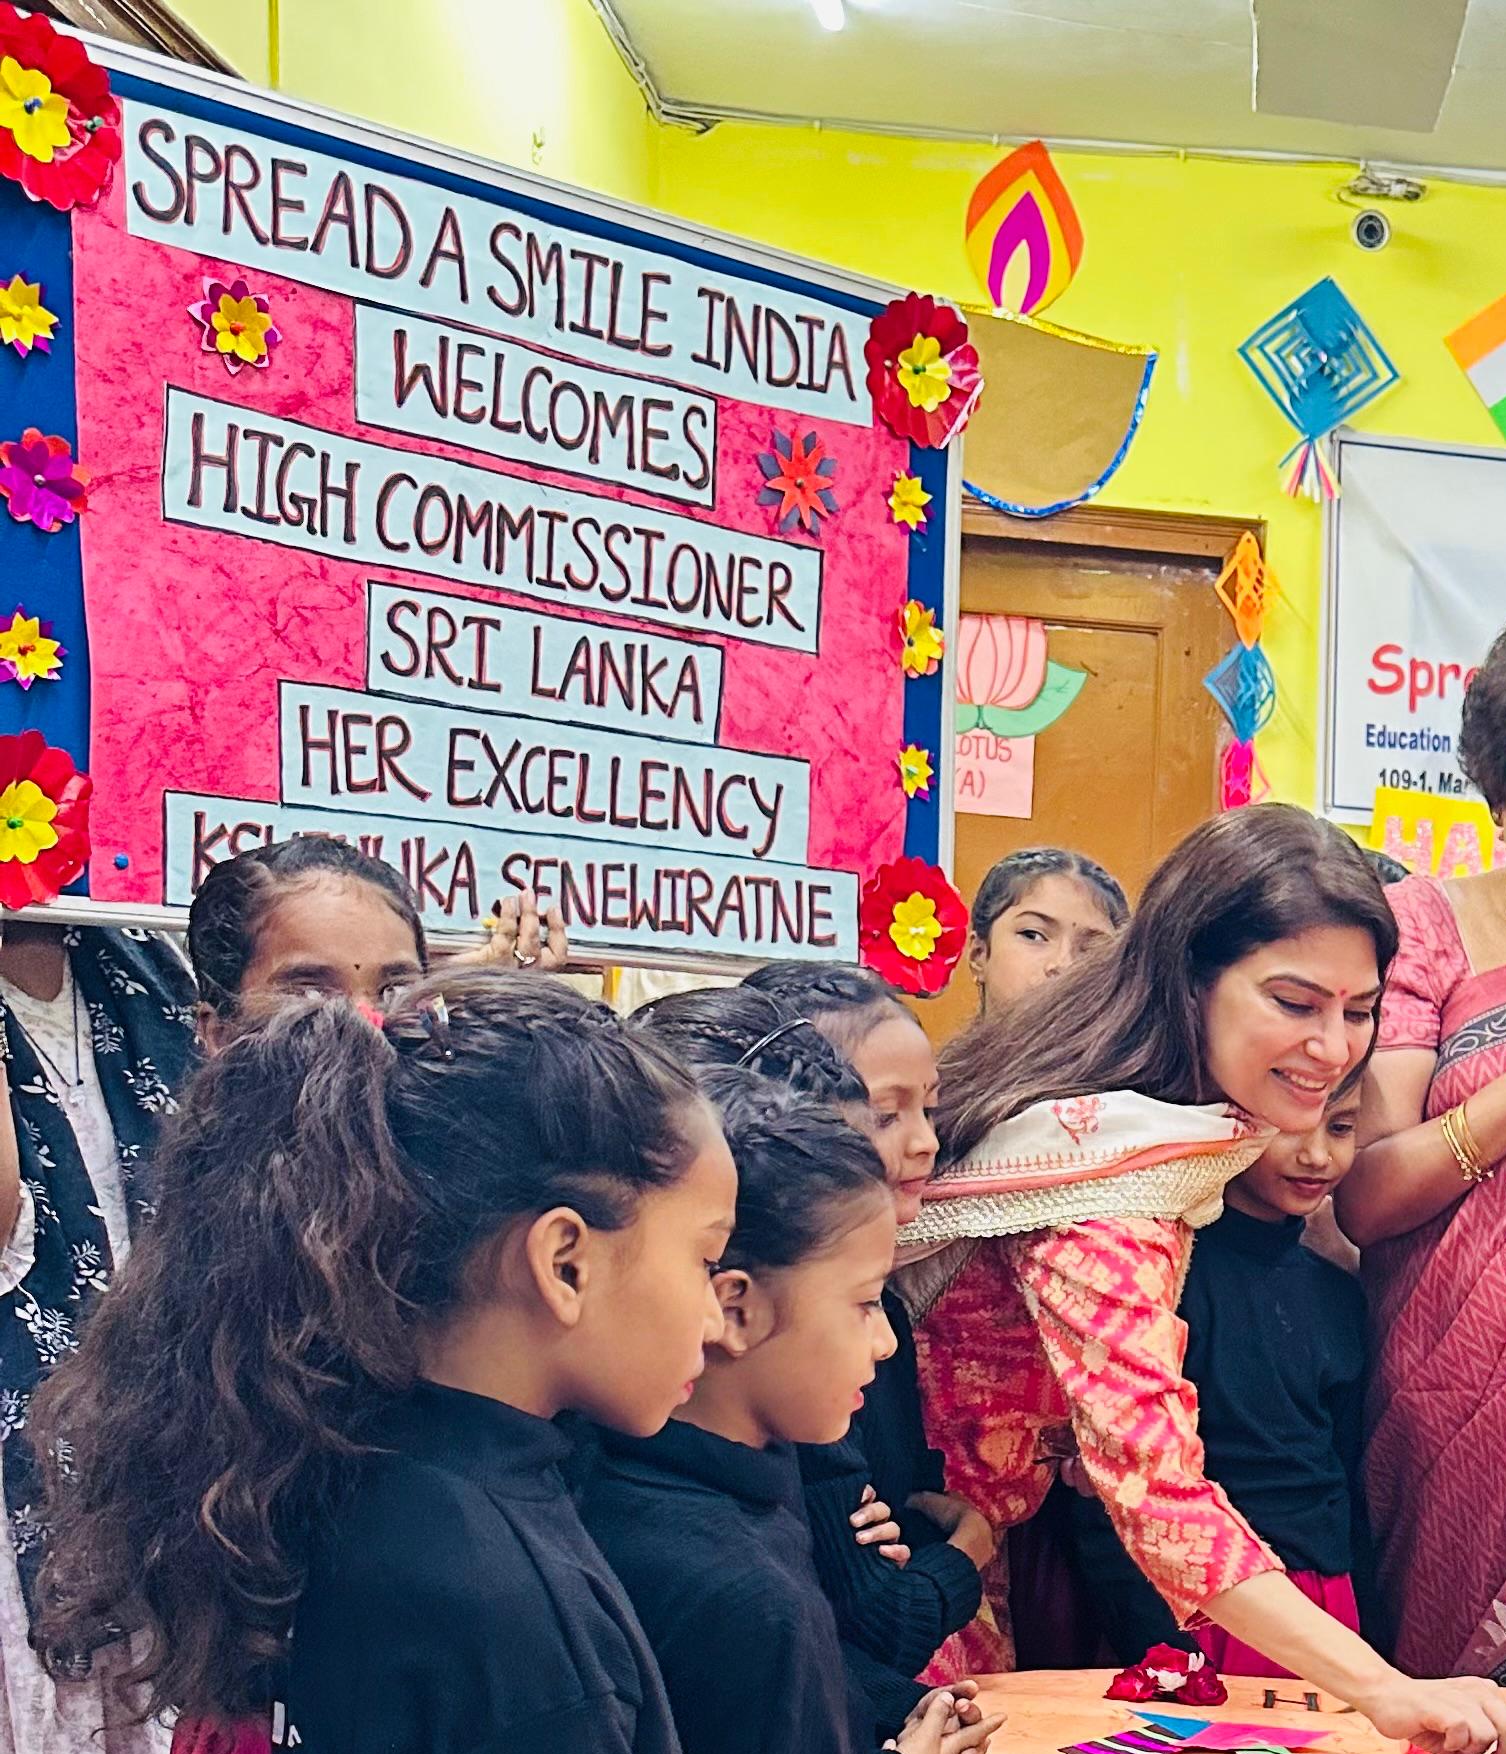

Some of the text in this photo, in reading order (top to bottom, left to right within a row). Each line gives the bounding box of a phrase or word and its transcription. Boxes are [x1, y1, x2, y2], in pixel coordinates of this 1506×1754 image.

[131, 117, 858, 402] SPREAD A SMILE INDIA
[393, 329, 713, 492] WELCOMES
[187, 412, 806, 633] HIGH COMMISSIONER
[379, 600, 705, 723] SRI LANKA
[1367, 643, 1480, 714] Spr
[299, 704, 784, 858] HER EXCELLENCY
[955, 735, 1012, 762] OTUS
[1366, 723, 1451, 753] Education
